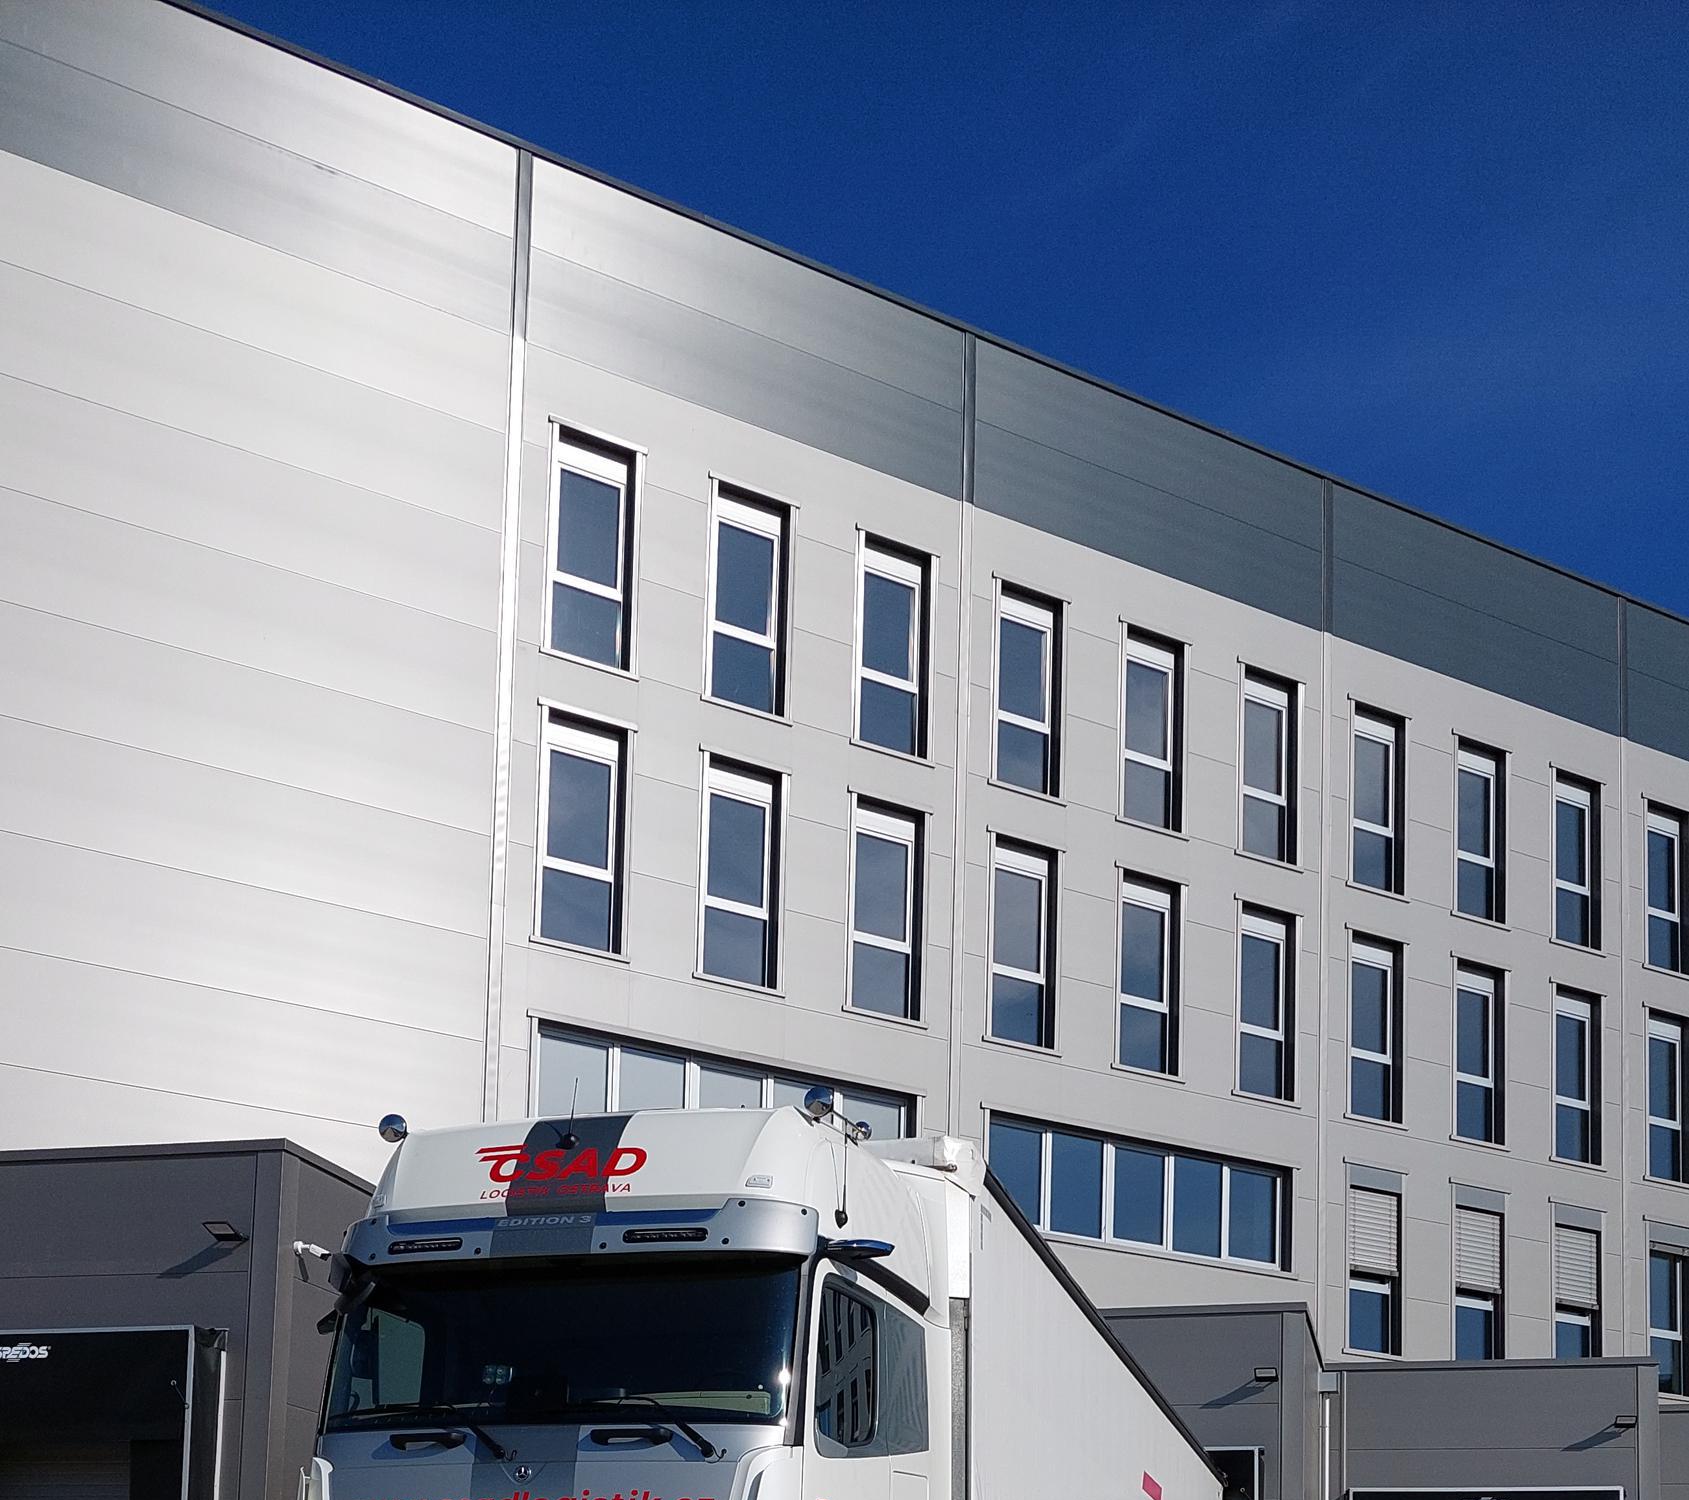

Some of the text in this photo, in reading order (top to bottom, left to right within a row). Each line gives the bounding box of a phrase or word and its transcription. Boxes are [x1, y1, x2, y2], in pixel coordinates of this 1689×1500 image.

[480, 1183, 631, 1200] LOGISTIK OSTRAVA
[497, 1215, 592, 1228] EDITION 3
